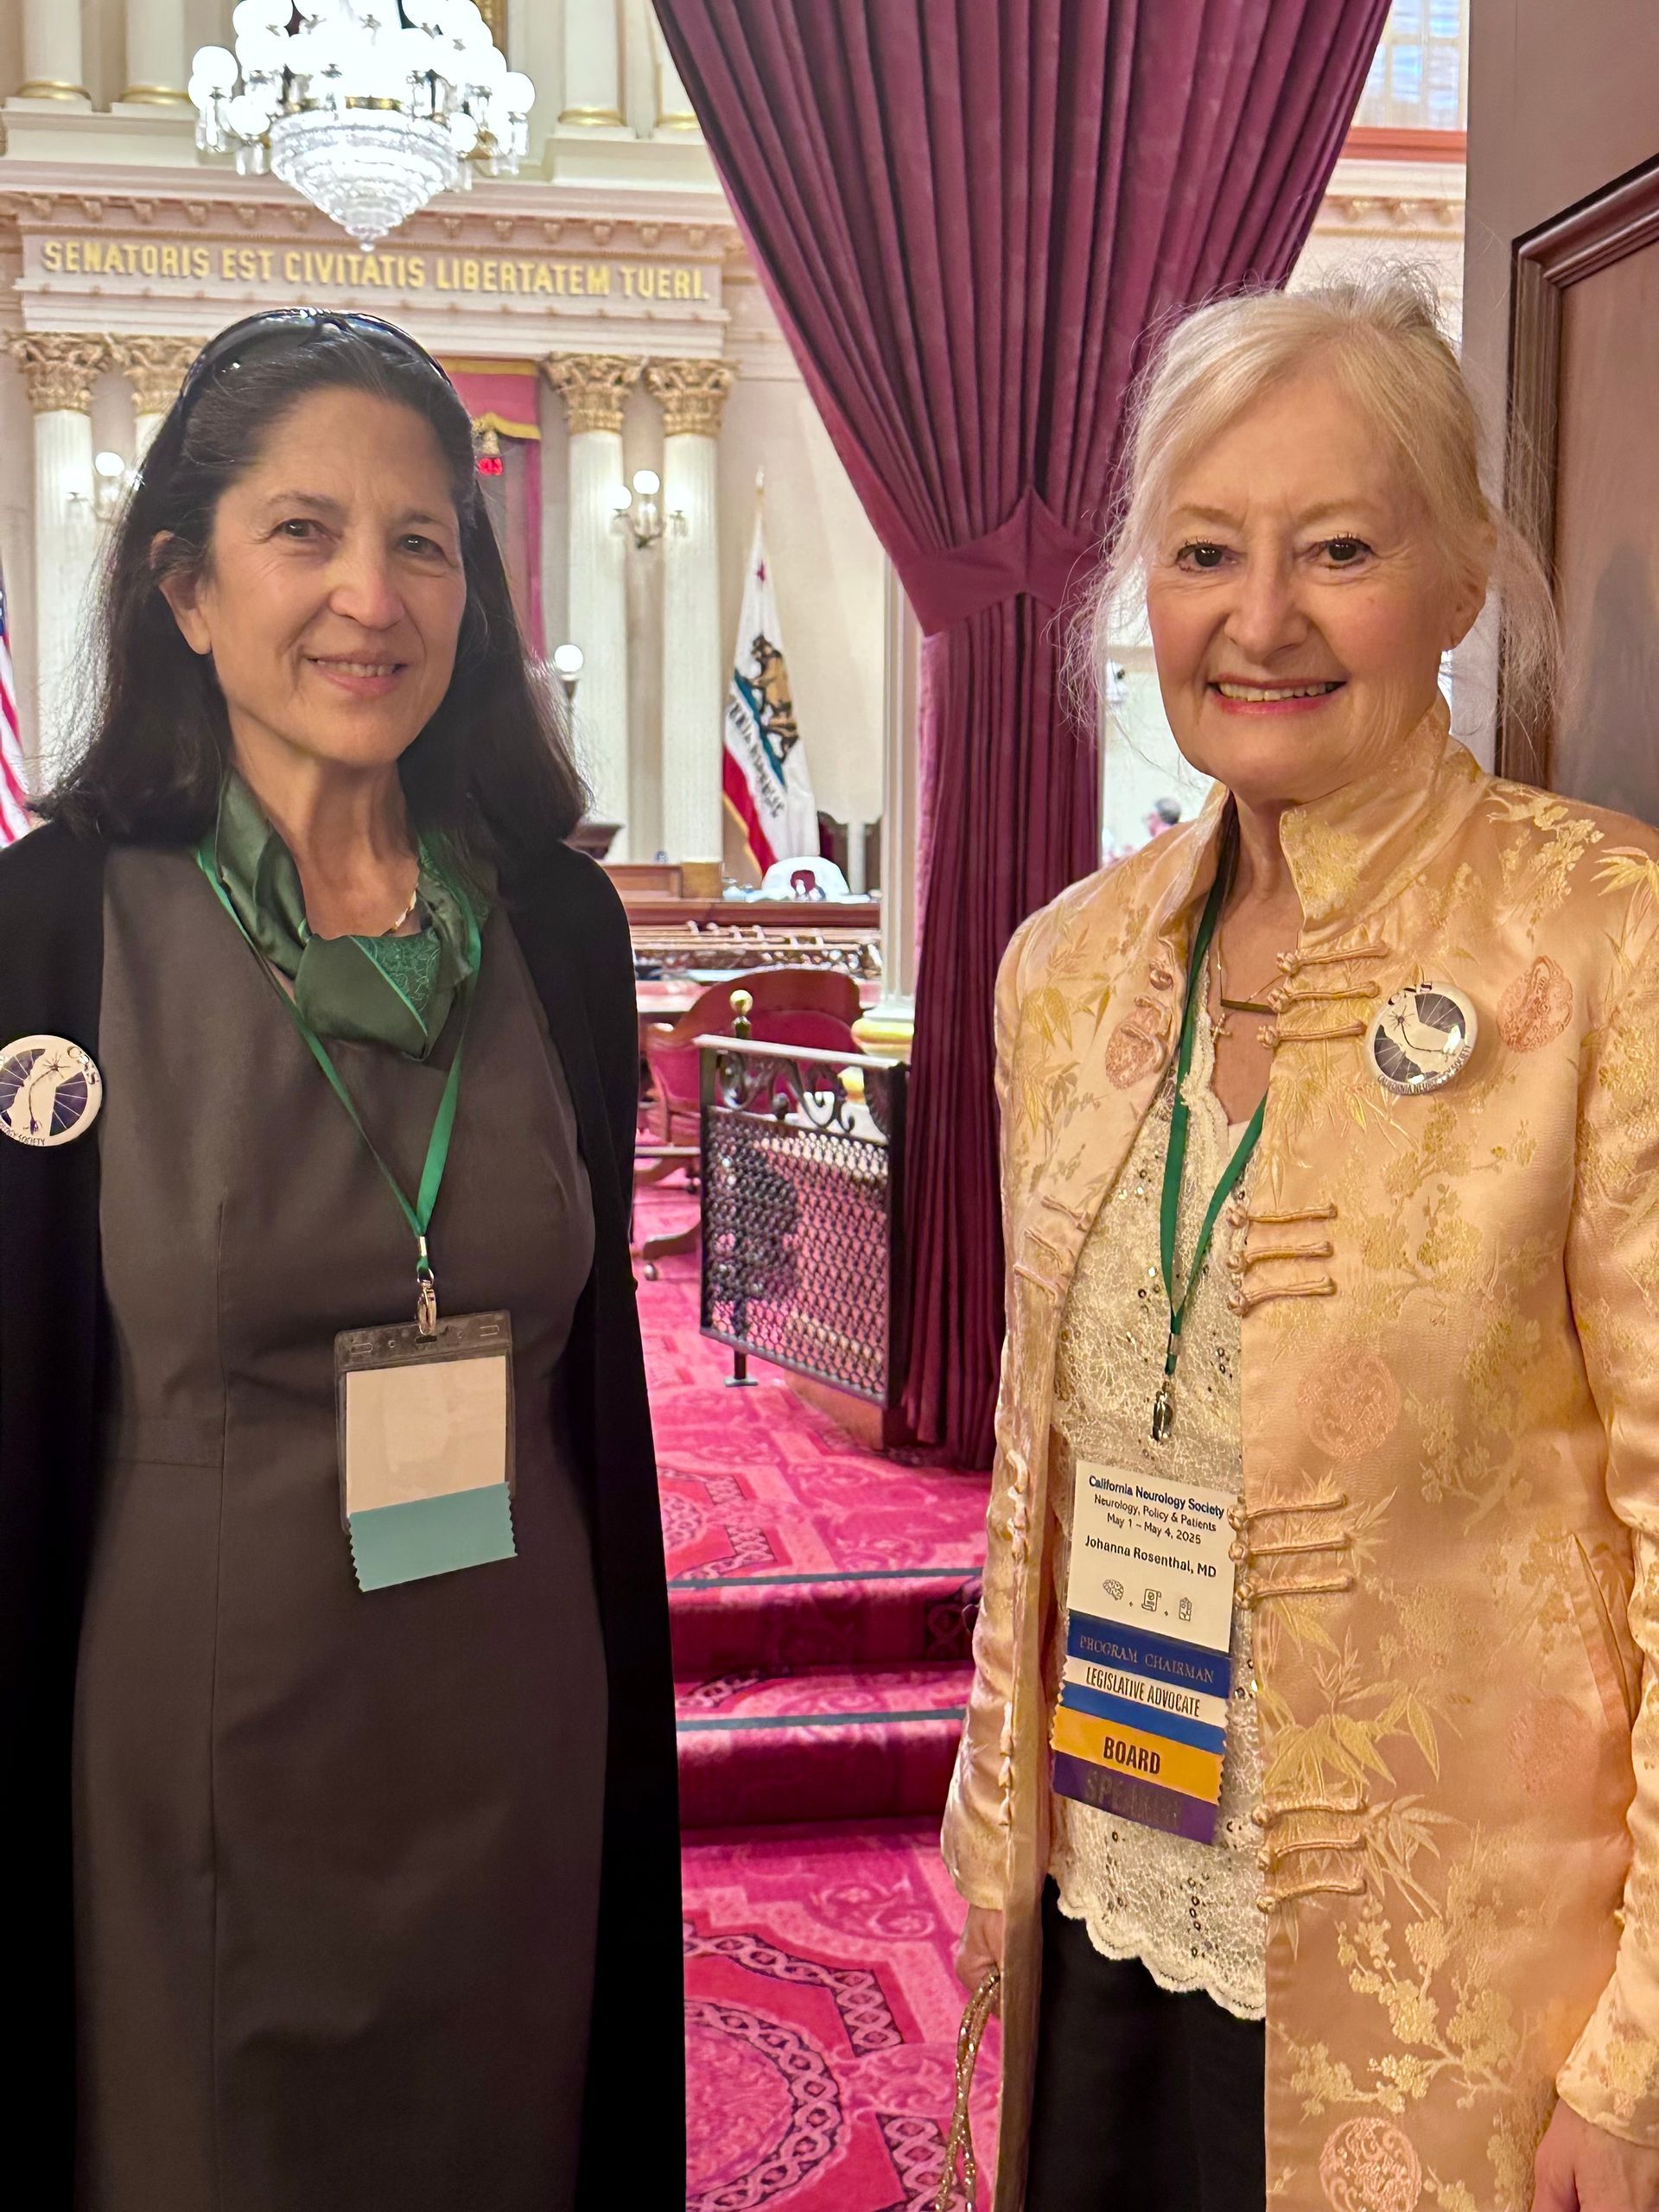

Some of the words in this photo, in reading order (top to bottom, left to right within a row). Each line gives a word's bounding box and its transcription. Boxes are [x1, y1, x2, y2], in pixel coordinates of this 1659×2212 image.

[44, 239, 213, 278] SENATORIS
[219, 247, 275, 282] EST
[283, 251, 426, 289] CIVITATIS
[436, 258, 610, 296] LIBERTATEM
[1089, 1475, 1133, 1496] California
[1135, 1486, 1186, 1510] Neurology
[1188, 1497, 1224, 1520] Society
[1094, 1494, 1141, 1516] Neurology,
[1143, 1505, 1168, 1522] Policy
[1171, 1512, 1179, 1522] &
[1181, 1514, 1217, 1532] Patients
[1107, 1512, 1124, 1529] May
[1128, 1519, 1133, 1528] 1
[1144, 1521, 1162, 1538] May
[1164, 1528, 1173, 1540] 4,
[1176, 1529, 1201, 1545] 2025
[1084, 1535, 1131, 1556] Johanna
[1134, 1547, 1194, 1574] Rosenthal,
[1198, 1562, 1217, 1578] MD
[1080, 1635, 1138, 1663] PROGRAM
[1145, 1653, 1214, 1684] CHAIRMAN
[1086, 1667, 1145, 1701] LEGISLATIVE
[1147, 1688, 1200, 1719] ADVOCATE
[1103, 1736, 1160, 1775] BOARD
